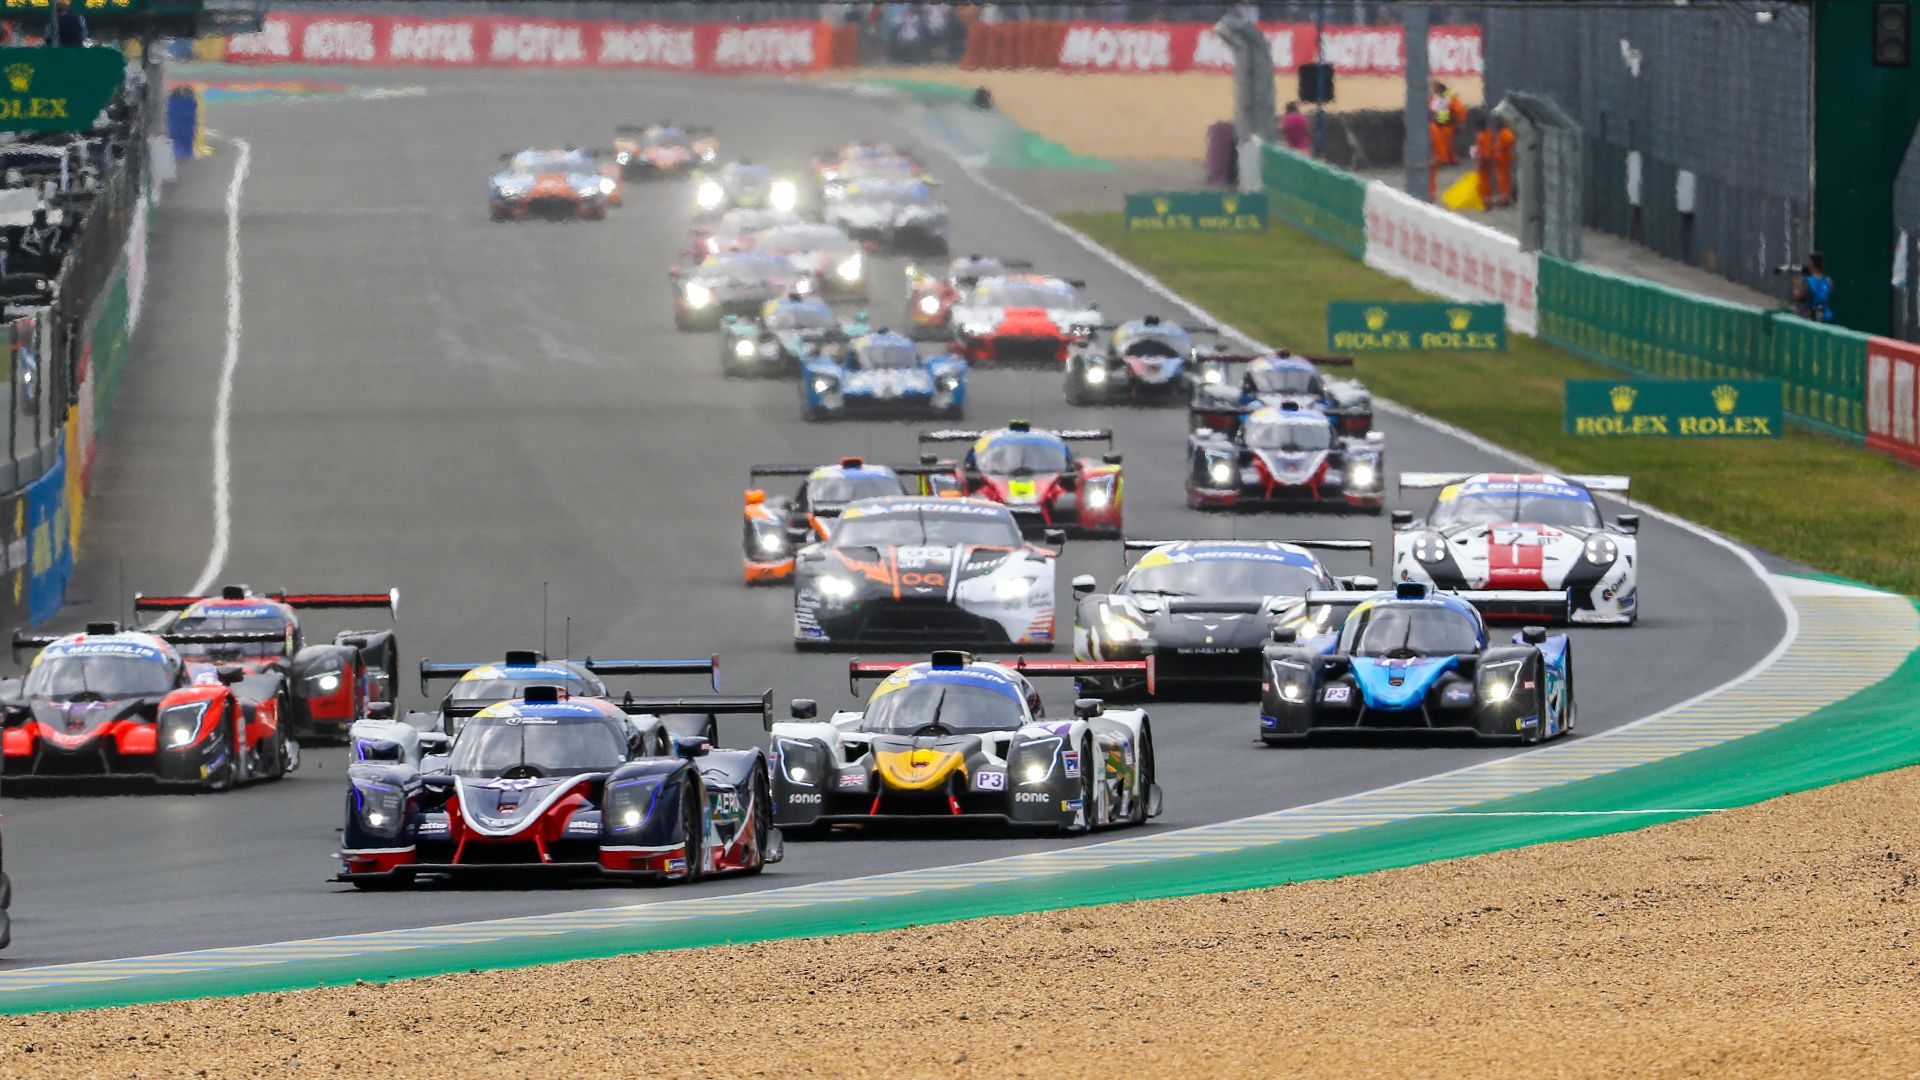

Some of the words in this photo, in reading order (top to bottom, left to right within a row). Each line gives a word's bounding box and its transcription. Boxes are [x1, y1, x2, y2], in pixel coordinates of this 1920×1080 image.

[1060, 27, 1170, 67] MOTUL
[1334, 331, 1410, 348] ROLEX
[1421, 332, 1496, 348] ROLEX
[1576, 415, 1668, 434] ROLEX
[1679, 416, 1771, 434] ROLEX
[67, 645, 154, 656] MICHELIN
[927, 669, 1006, 684] MICHELIN
[1327, 690, 1347, 699] P3
[979, 774, 1002, 788] P3
